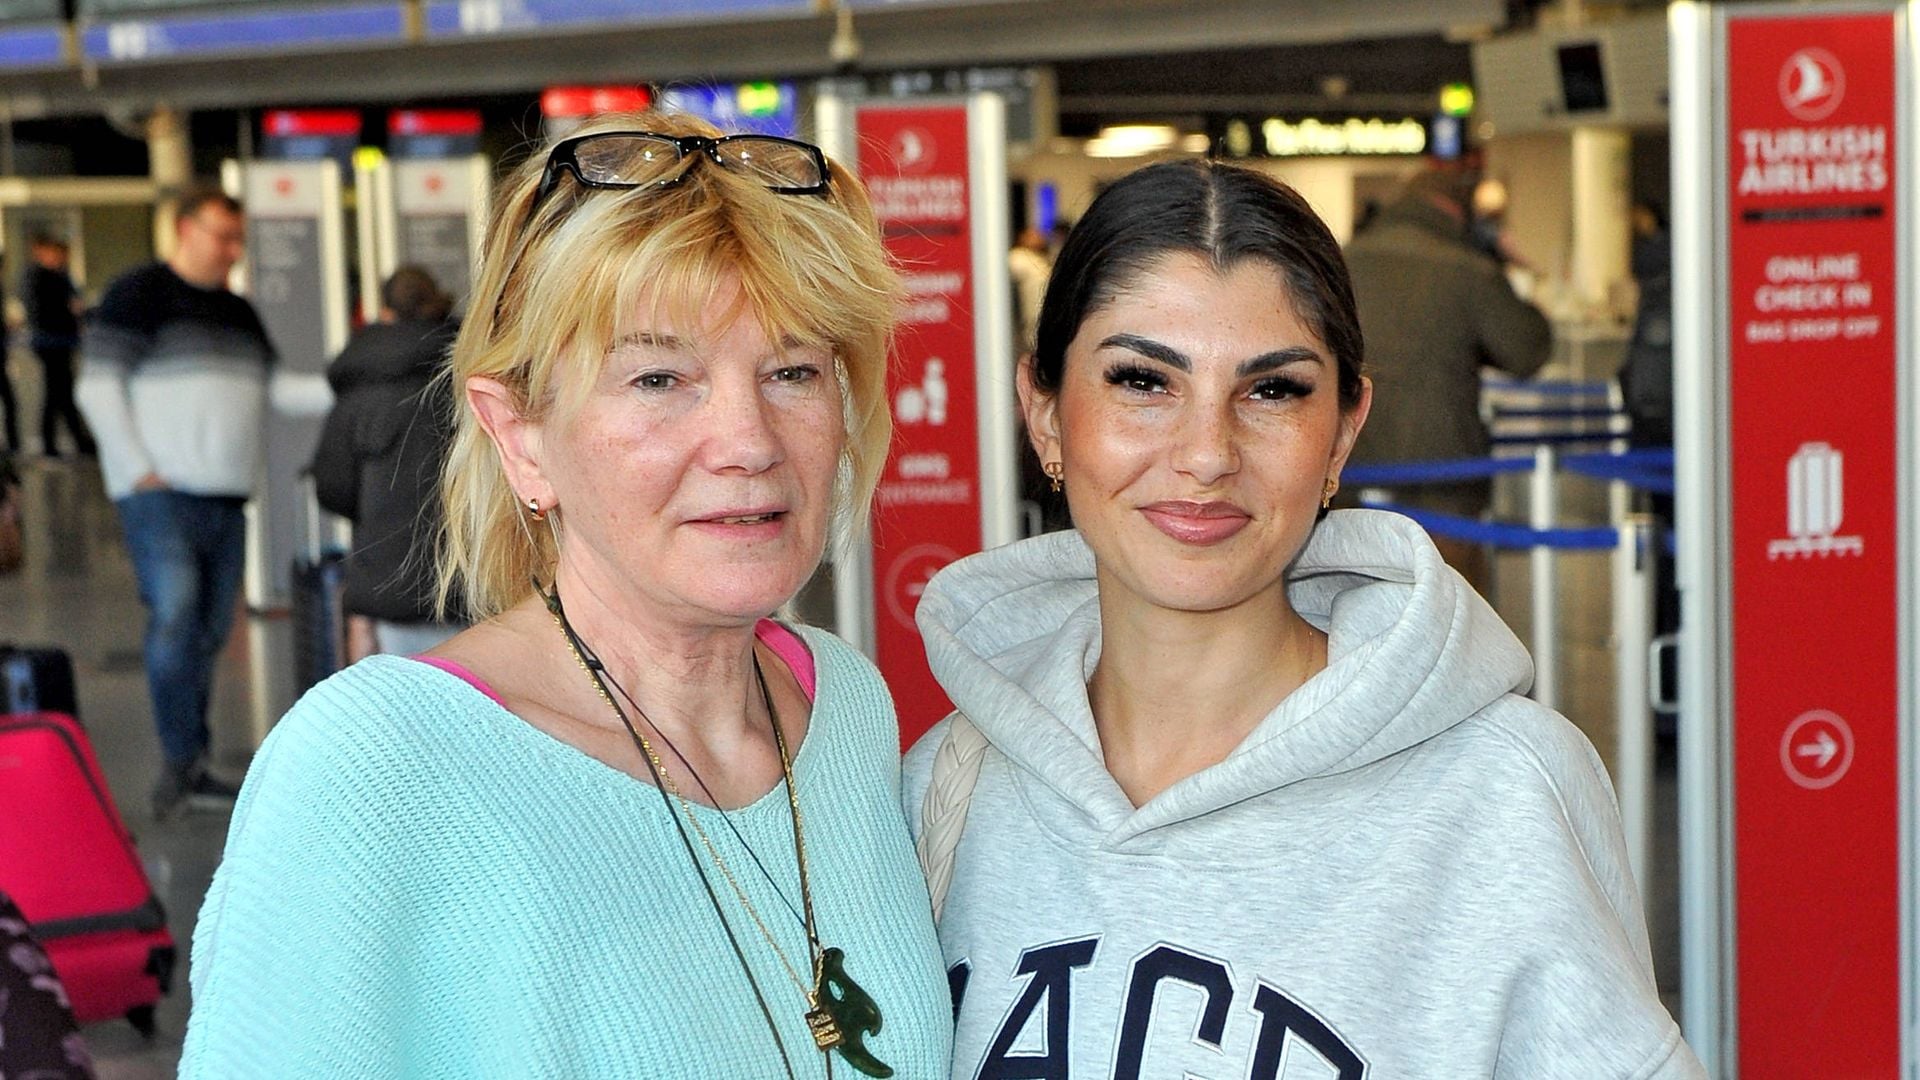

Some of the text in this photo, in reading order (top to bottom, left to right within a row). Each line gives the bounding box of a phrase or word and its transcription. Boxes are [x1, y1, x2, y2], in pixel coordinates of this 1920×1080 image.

[1739, 126, 1886, 162] TURKISH
[1738, 158, 1887, 195] AIRLINES
[1765, 254, 1859, 283] ONLINE
[1754, 282, 1872, 312] CHECK IN
